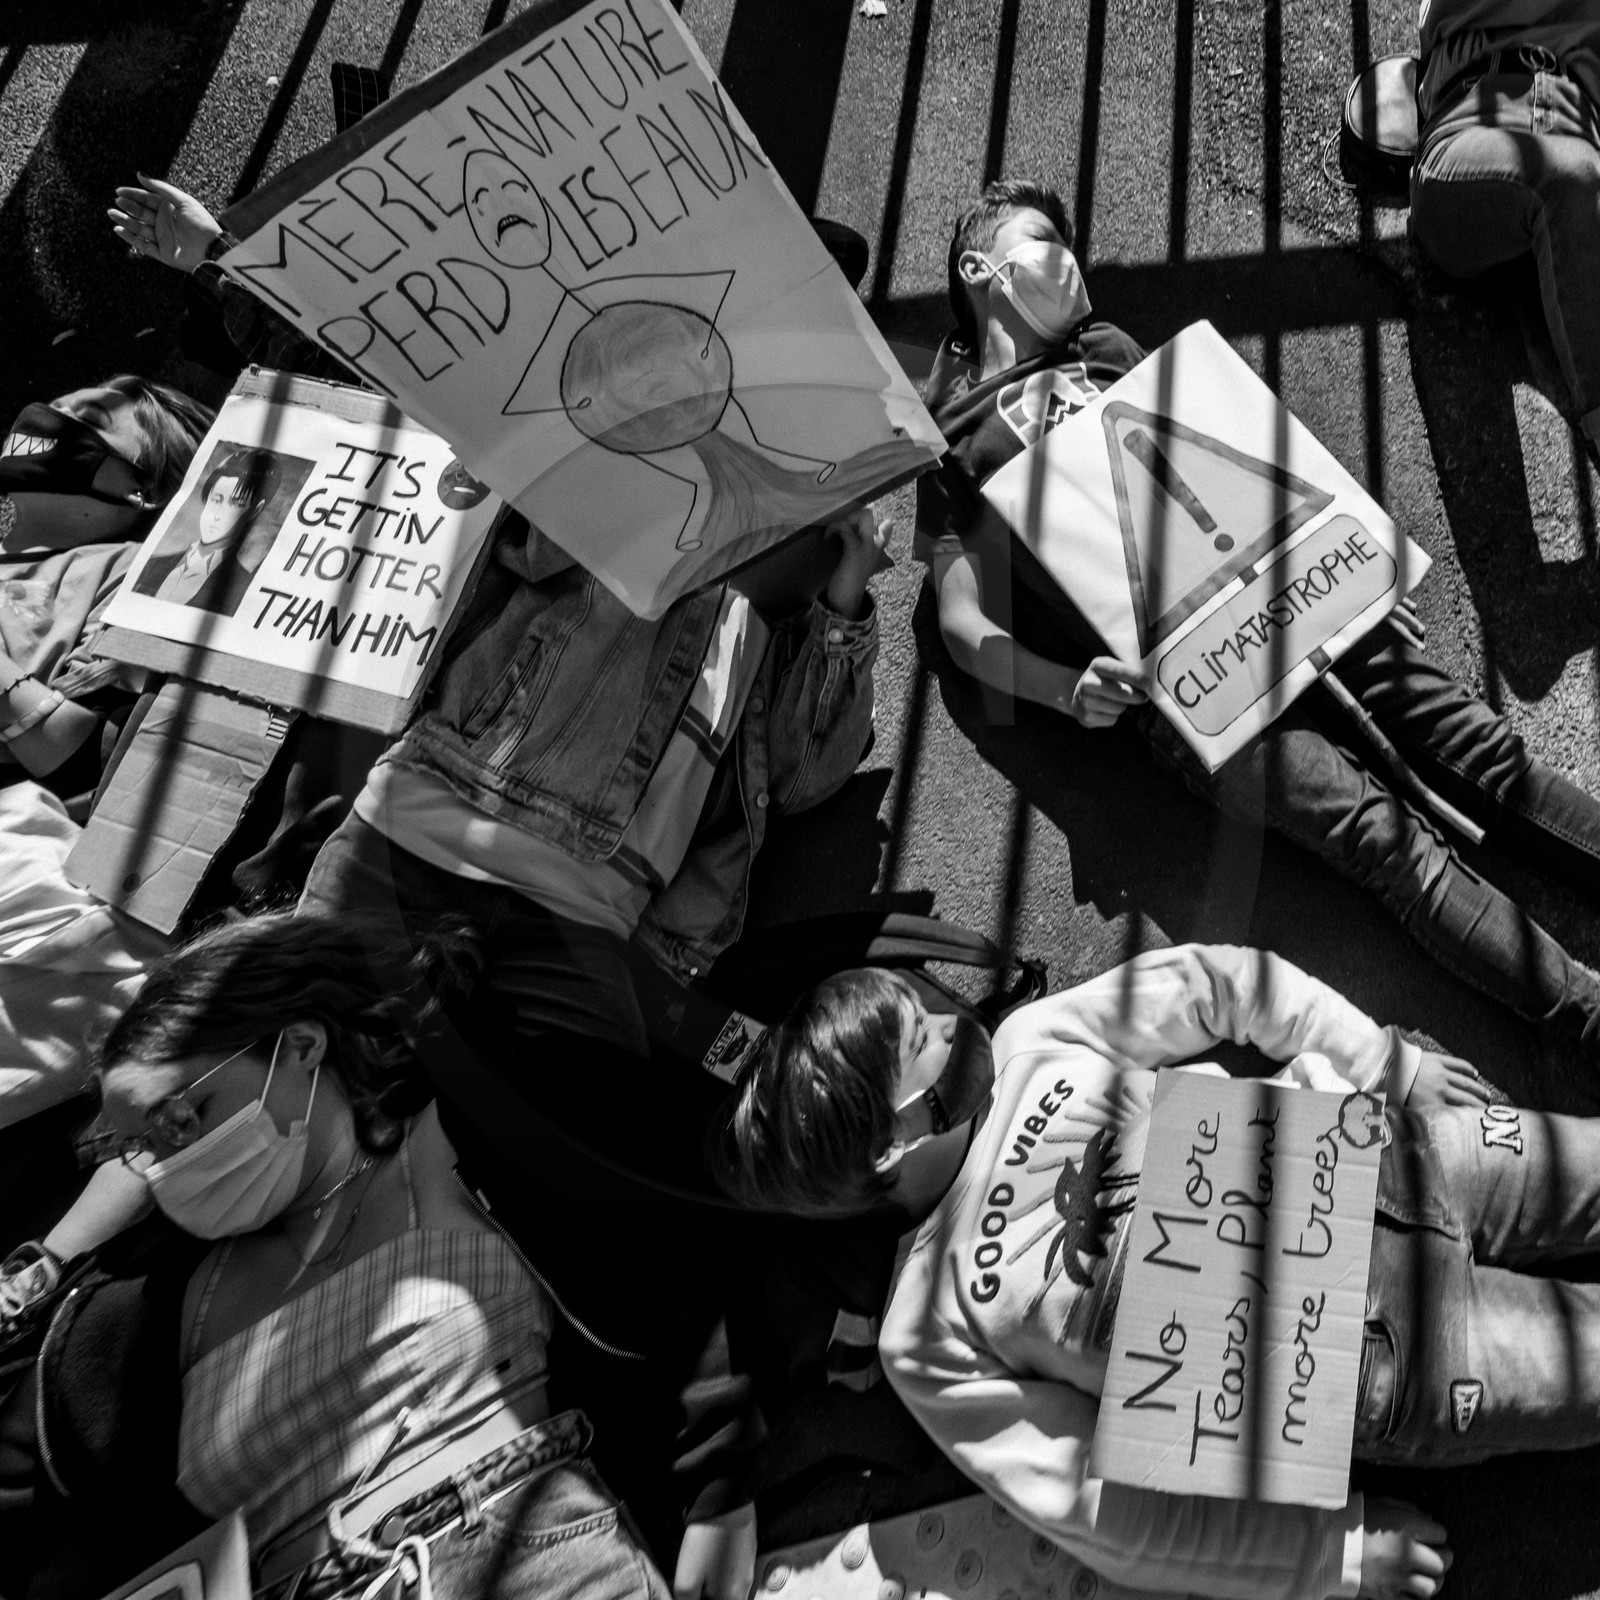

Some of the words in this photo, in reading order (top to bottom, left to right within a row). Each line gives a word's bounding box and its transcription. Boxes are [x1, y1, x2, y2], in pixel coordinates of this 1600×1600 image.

[316, 257, 511, 399] PERD
[541, 165, 637, 272] LES
[600, 80, 769, 233] EAUX
[325, 442, 426, 499] IT'S
[252, 586, 356, 647] THAN
[283, 533, 443, 599] HOTTER
[970, 1183, 1015, 1304] GOOD
[1004, 1078, 1075, 1167] VIBES
[1142, 1111, 1220, 1273] More
[1216, 1105, 1281, 1250] Plant
[1122, 1309, 1187, 1413] No
[1281, 1291, 1326, 1446] more
